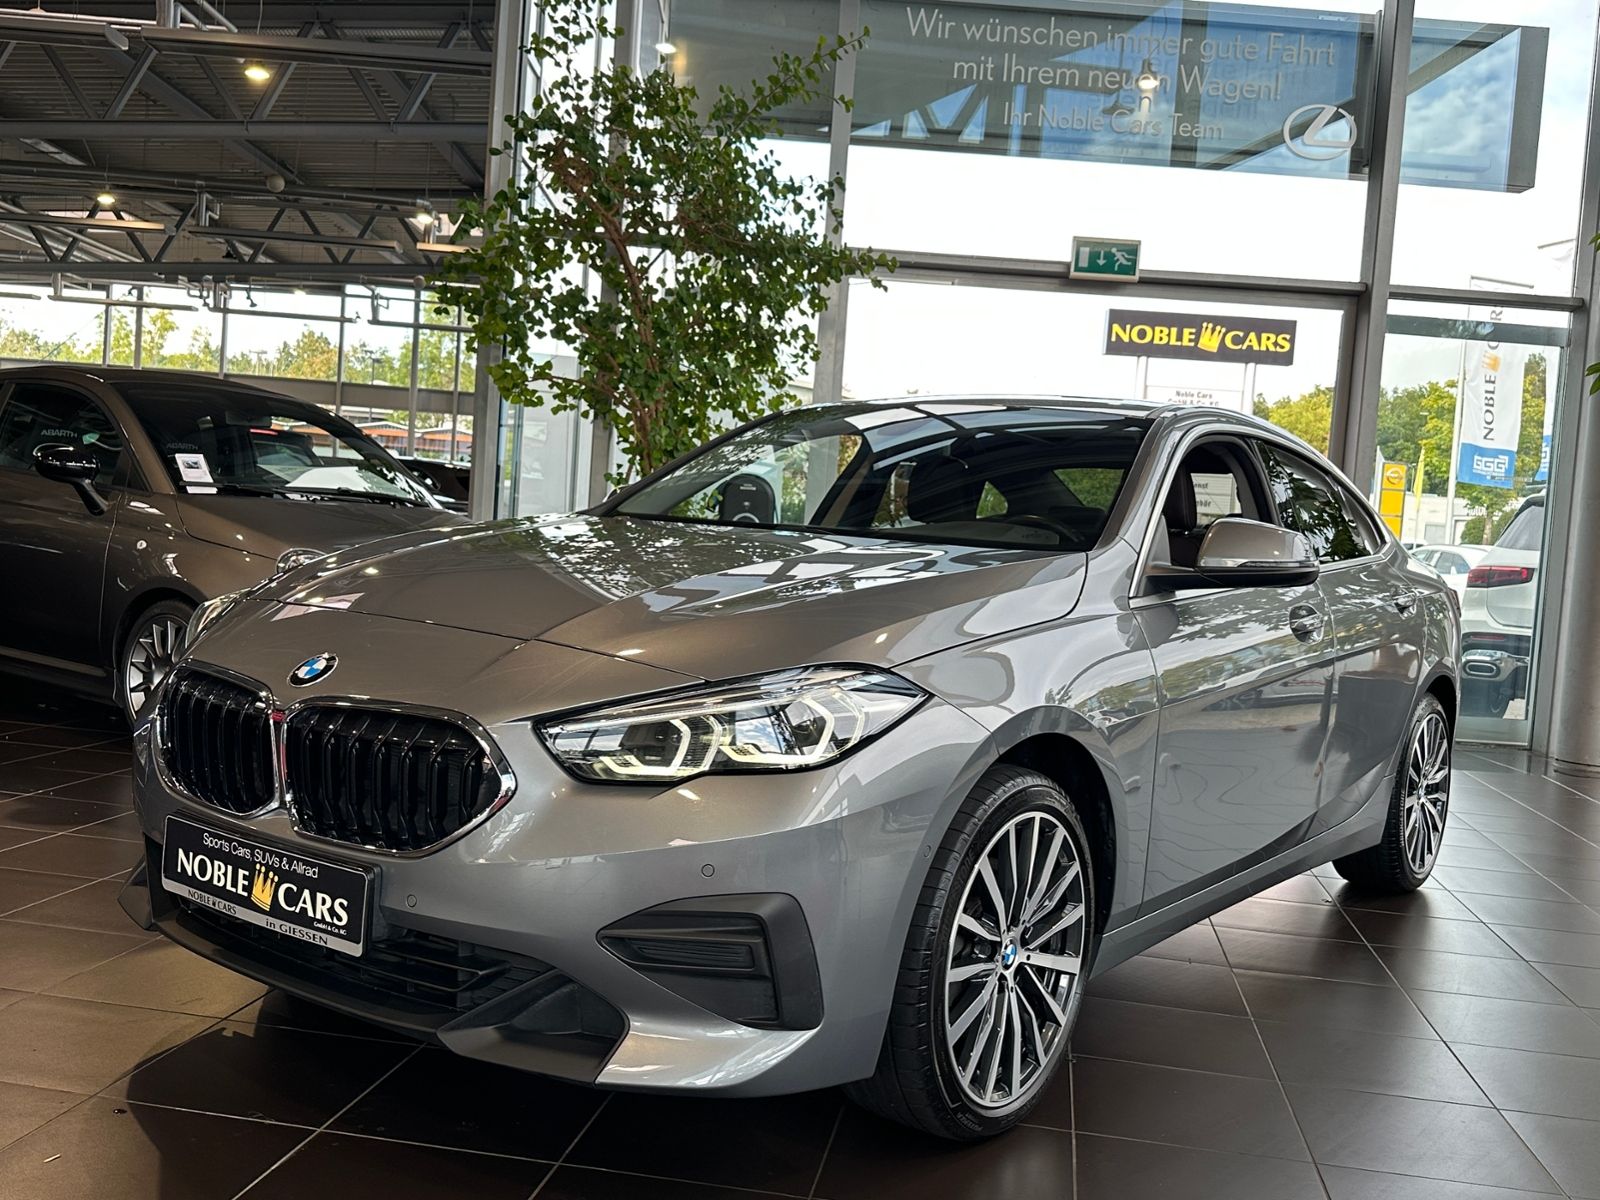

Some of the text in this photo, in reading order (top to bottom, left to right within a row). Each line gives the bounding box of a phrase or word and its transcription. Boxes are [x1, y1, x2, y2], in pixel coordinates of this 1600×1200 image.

[906, 7, 1335, 66] Wir wünschen immer gute Fahrt
[953, 56, 995, 81] mit
[1003, 53, 1079, 86] Ihrem
[1180, 64, 1282, 103] Wagen!
[1004, 102, 1224, 139] Ihr Noble Cars Team
[1111, 323, 1292, 353] NOBLE CARS
[1483, 375, 1497, 441] NOBLE
[40, 429, 78, 439] ABARTH
[203, 832, 319, 878] Sports Cars, SUVs & Allrad
[177, 848, 348, 926] NOBLE CARS
[188, 889, 237, 915] NOBLE CARS
[265, 918, 328, 945] in GIESSEN
